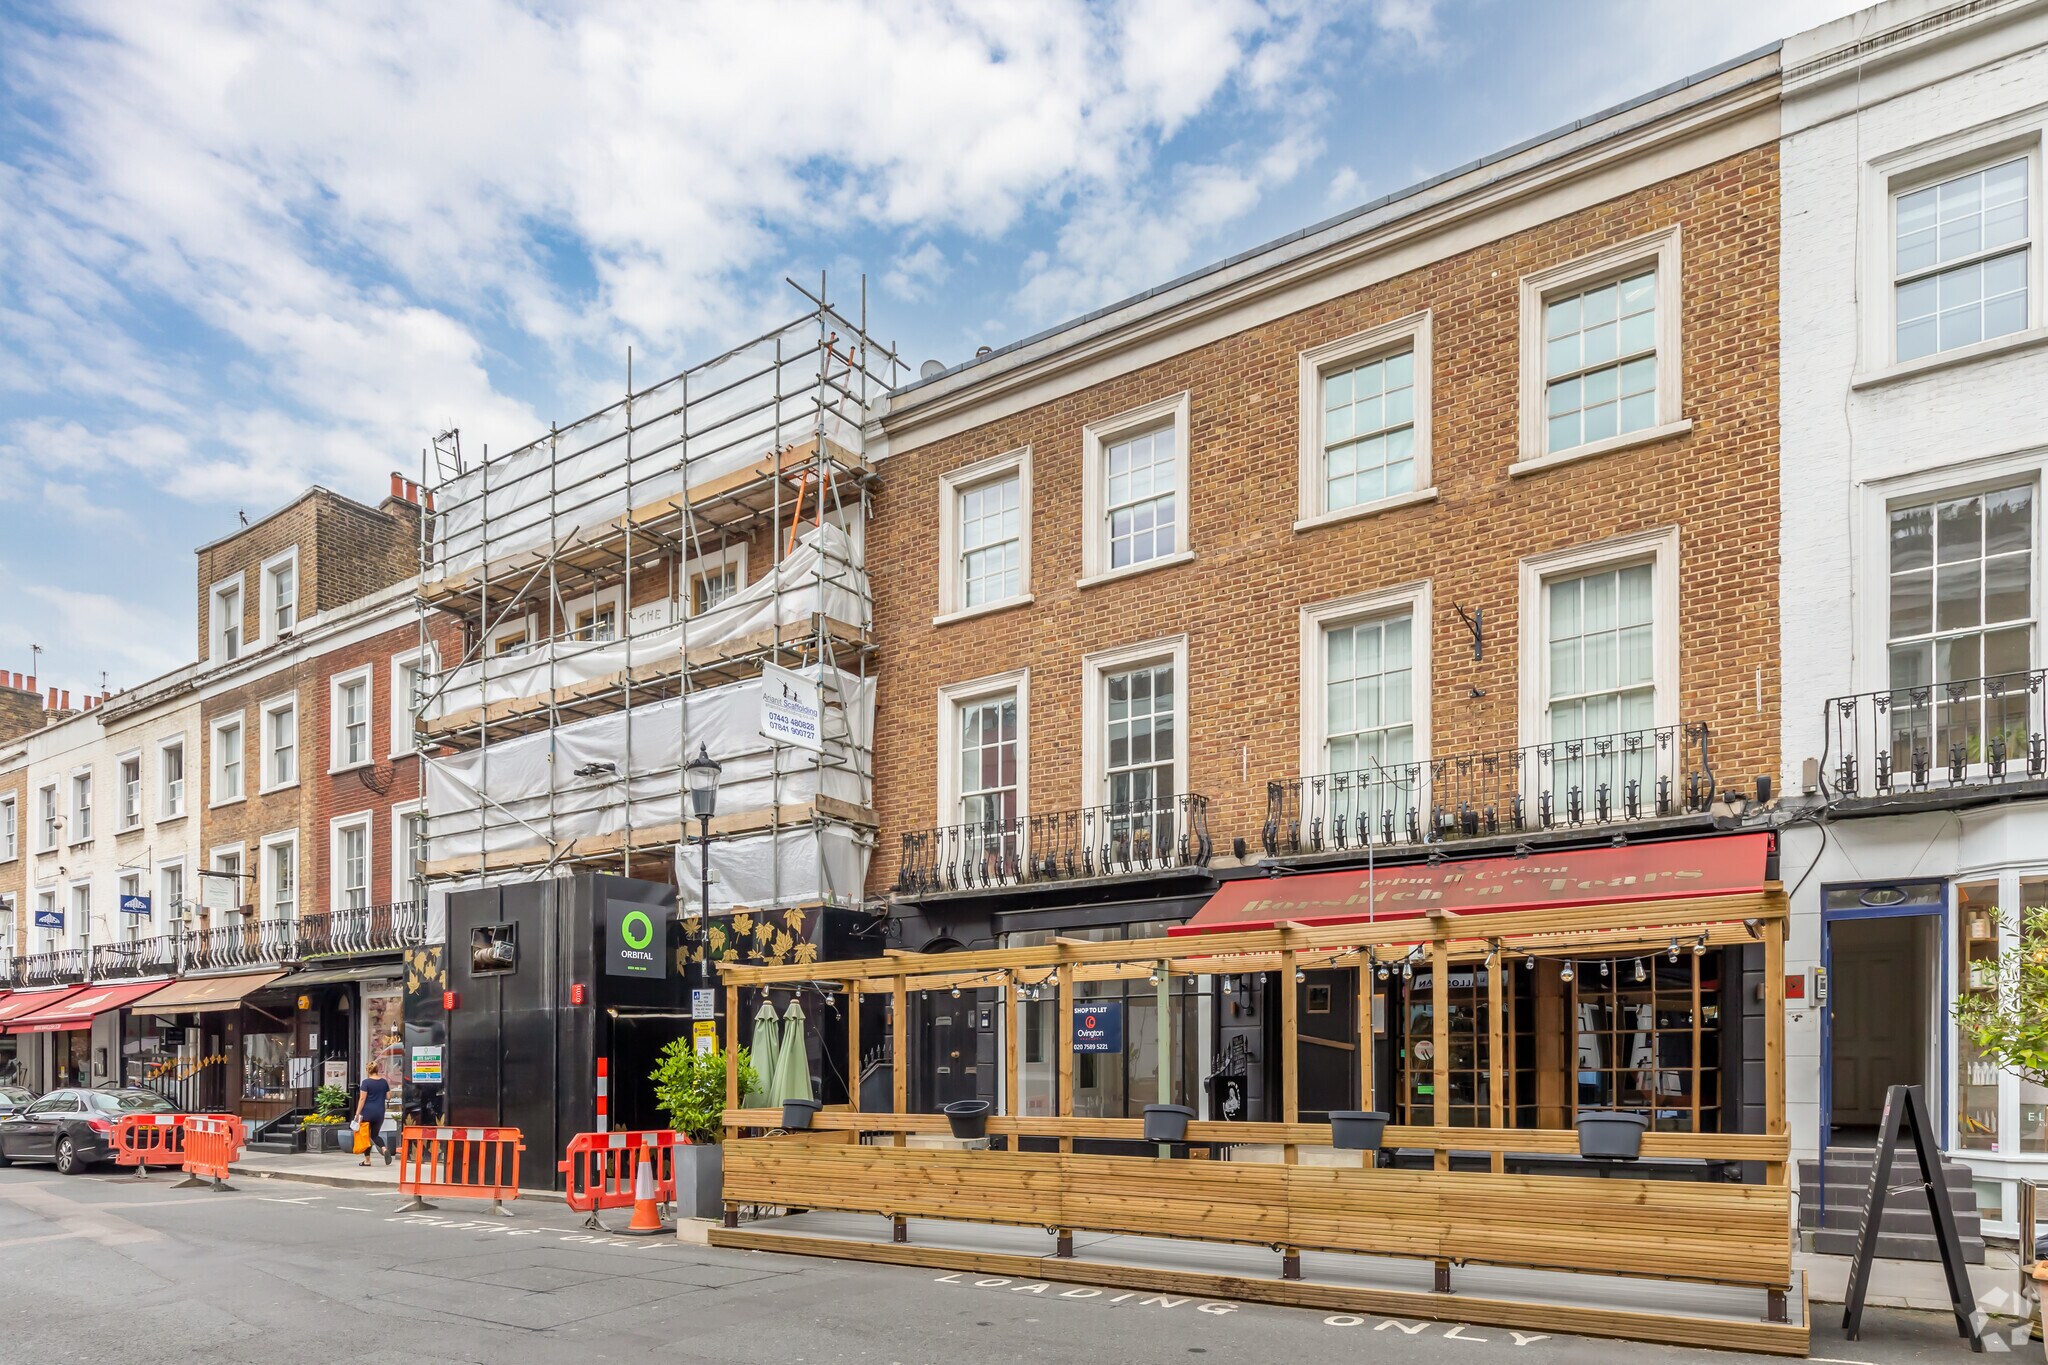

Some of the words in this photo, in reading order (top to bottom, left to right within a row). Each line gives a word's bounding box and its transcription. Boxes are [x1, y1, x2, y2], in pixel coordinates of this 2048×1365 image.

[639, 609, 662, 624] THE
[783, 699, 818, 718] Scaffolding
[769, 712, 789, 725] 07443
[790, 727, 815, 740] 900727
[1541, 870, 1704, 892] Tears
[1872, 891, 1891, 903] 47
[621, 950, 653, 960] ORBITAL
[1078, 1029, 1104, 1038] Ovington
[934, 1273, 1238, 1315] LOADING
[1323, 1315, 1552, 1346] ONLY
